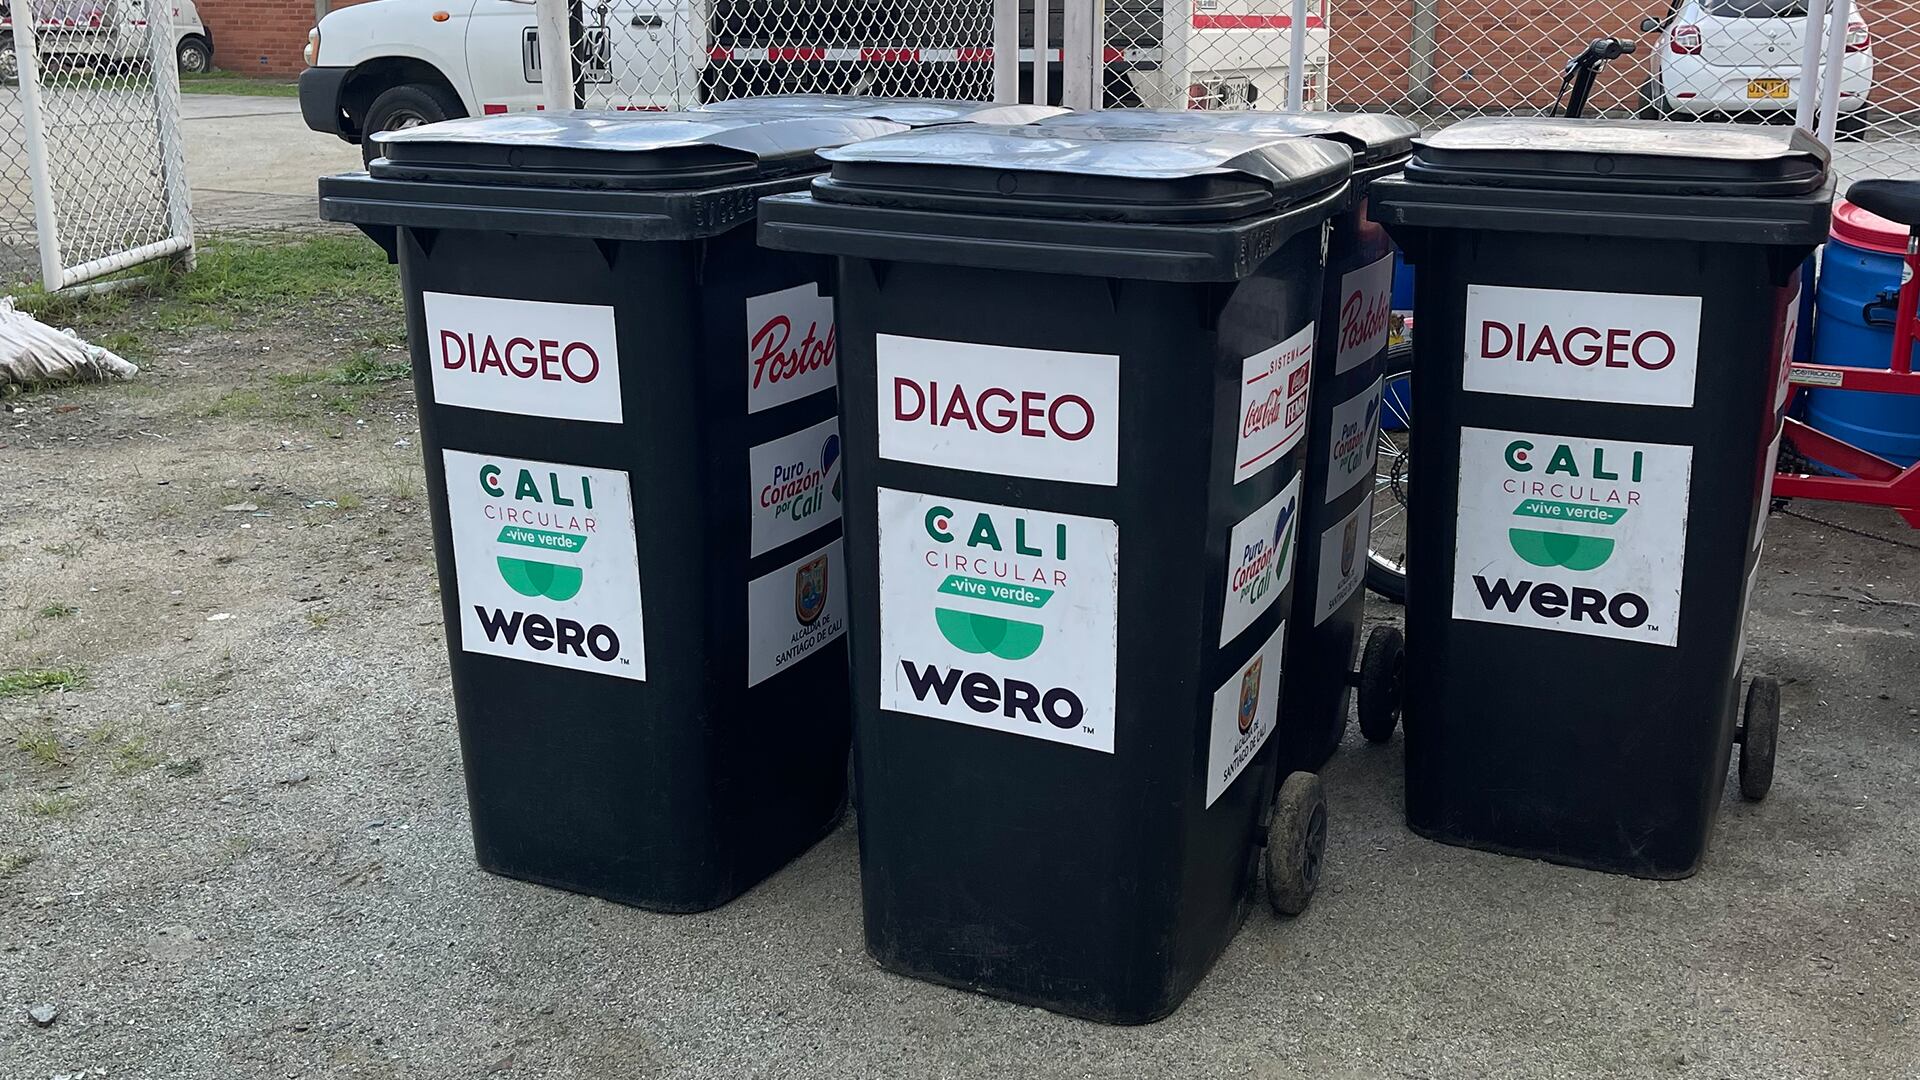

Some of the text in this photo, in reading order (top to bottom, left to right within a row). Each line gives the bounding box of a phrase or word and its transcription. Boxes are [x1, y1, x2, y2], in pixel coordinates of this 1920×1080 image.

[440, 330, 600, 384] DIAGEO
[1481, 321, 1675, 371] DIAGEO
[894, 377, 1095, 442] DIAGEO
[774, 462, 804, 486] Puro
[1505, 440, 1643, 483] CALI
[480, 464, 593, 510] CALI
[761, 468, 820, 508] Corazón
[775, 485, 823, 521] por Cali
[1503, 479, 1641, 506] CIRCULAR
[484, 505, 596, 533] CIRCULAR
[925, 506, 1067, 561] CALI
[926, 551, 1067, 588] CIRCULAR
[1233, 545, 1273, 592] Corazón
[1243, 539, 1264, 567] Puro
[1240, 563, 1273, 604] por Cali
[822, 614, 831, 625] DE
[776, 618, 843, 667] SANTIAGO DE CALI
[1223, 745, 1249, 782] SANTIAGO
[1249, 736, 1256, 752] DE
